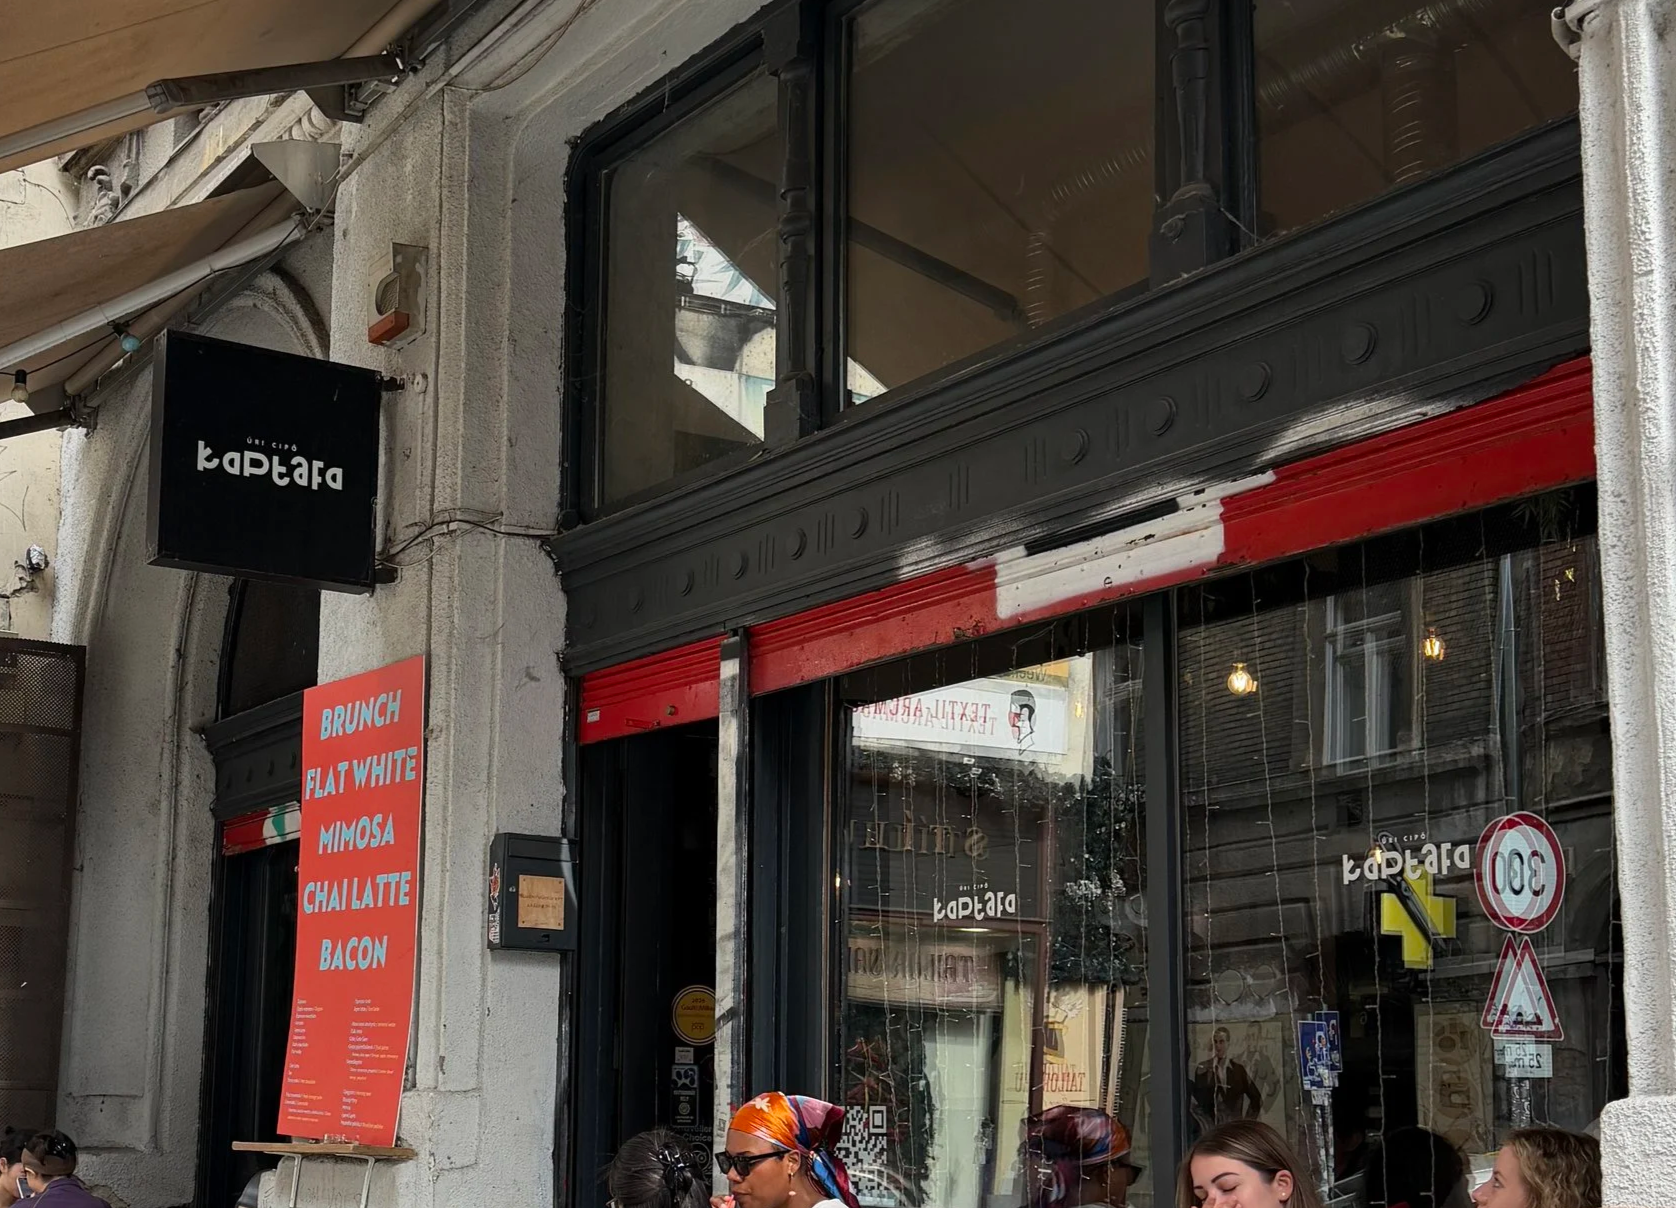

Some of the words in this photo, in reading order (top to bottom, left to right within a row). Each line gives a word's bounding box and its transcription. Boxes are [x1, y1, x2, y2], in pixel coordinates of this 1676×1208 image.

[320, 689, 401, 741] BRUNCH
[305, 760, 349, 800] FLAT
[353, 746, 418, 789] WHITE
[318, 812, 395, 855] MIMOSA
[303, 877, 348, 914] CHAI
[350, 871, 411, 911] LATTE
[318, 935, 388, 971] BACON
